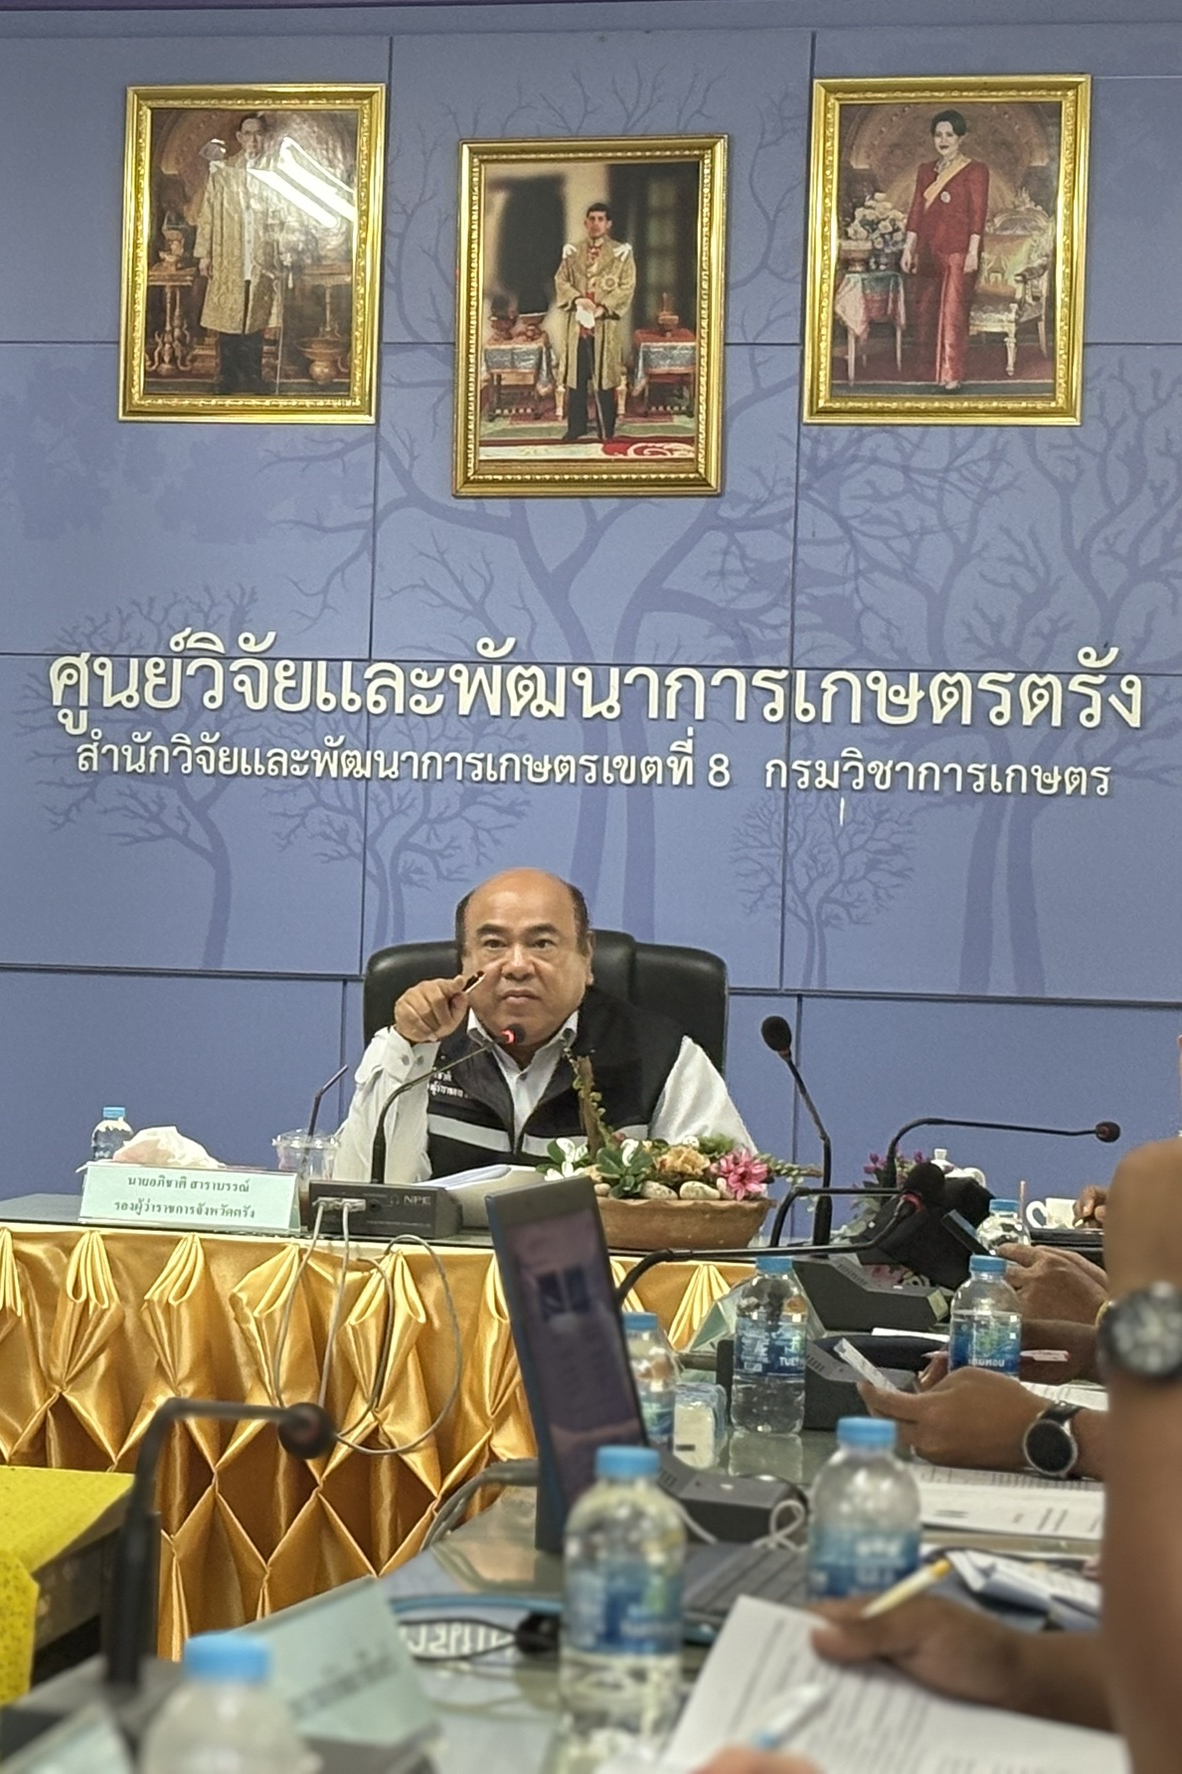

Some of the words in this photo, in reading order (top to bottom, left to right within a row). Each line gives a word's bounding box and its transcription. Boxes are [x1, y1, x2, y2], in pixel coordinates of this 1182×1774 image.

[49, 627, 1142, 735] ศูนย์วิจัยและพัฒนาการเกษตรตรัง
[76, 726, 694, 787] สำนักวิจัยและพัฒนาการเกษตรเขตที่
[708, 753, 730, 787] 8
[765, 747, 1111, 796] กรมวิชาการเกษตร
